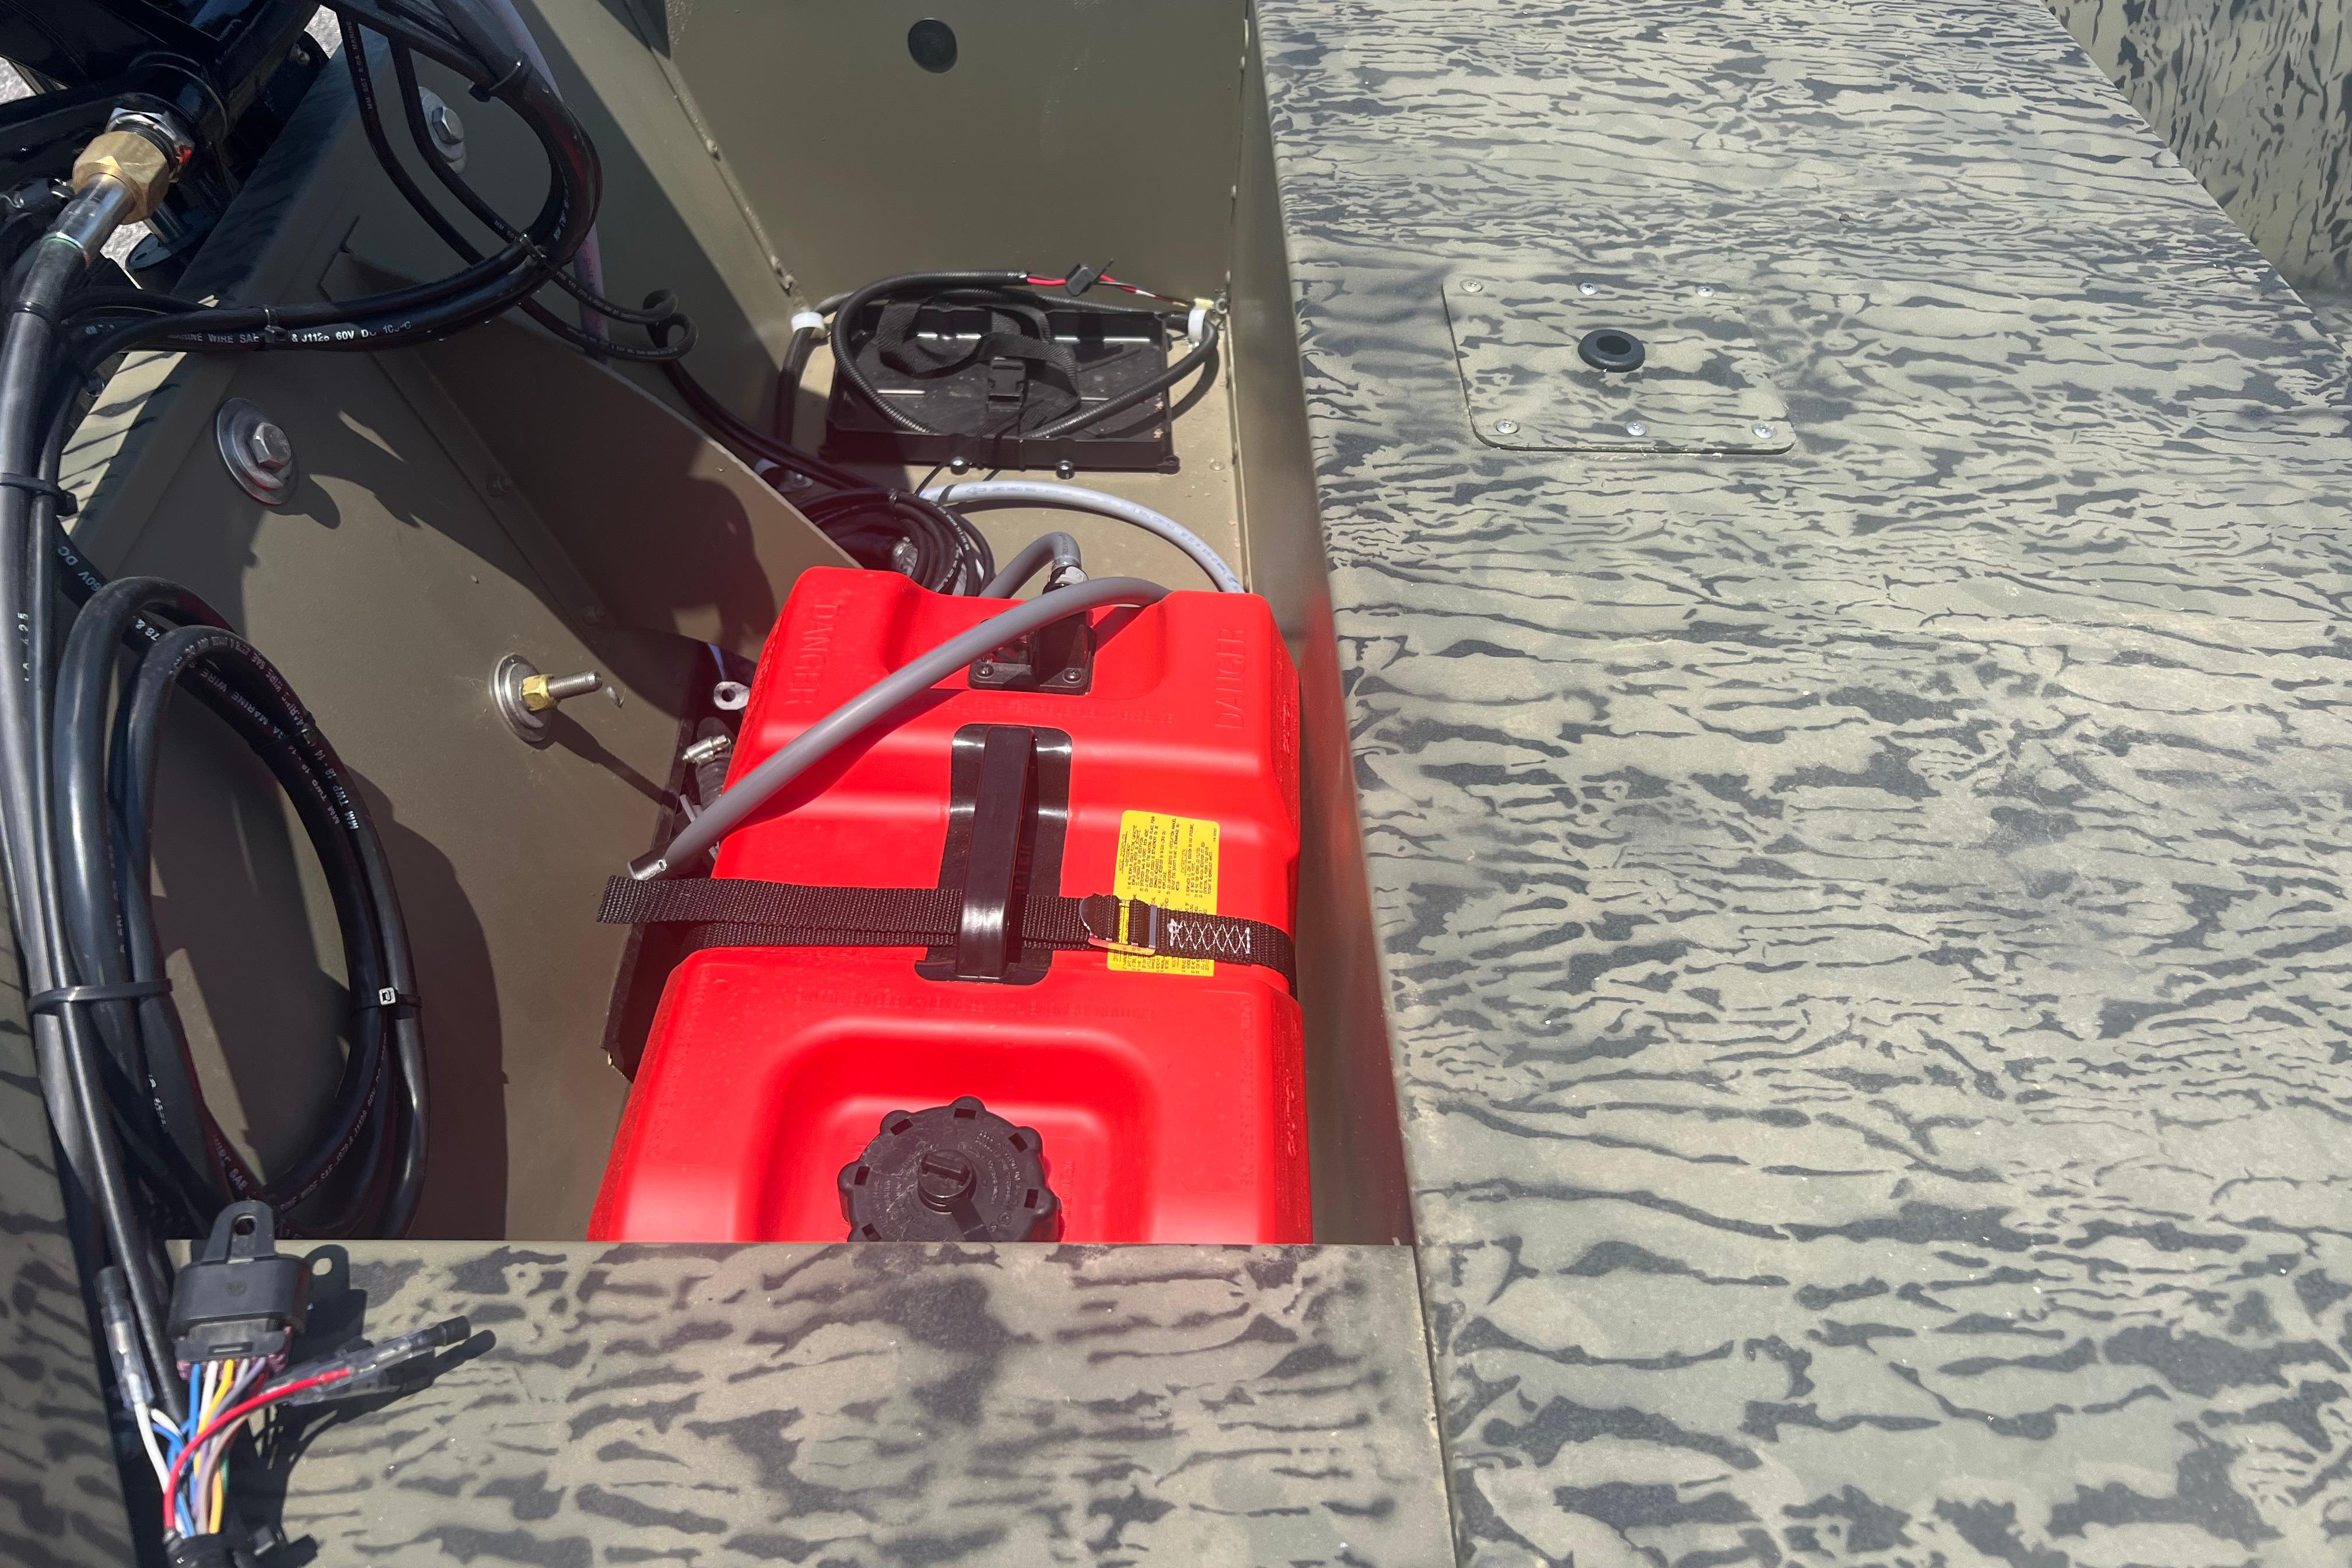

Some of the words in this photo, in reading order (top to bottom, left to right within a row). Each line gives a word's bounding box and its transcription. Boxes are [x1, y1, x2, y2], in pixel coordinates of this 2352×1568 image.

[208, 334, 233, 344] WIRE
[239, 333, 260, 343] SAE
[291, 334, 298, 342] &
[335, 330, 355, 341] 60V
[57, 545, 79, 566] DC
[785, 603, 838, 707] DANGER
[200, 669, 228, 692] WIRE
[1214, 628, 1247, 730] DANGER
[230, 691, 268, 725] MARINE
[332, 784, 349, 806] TWP
[345, 810, 359, 830] MM
